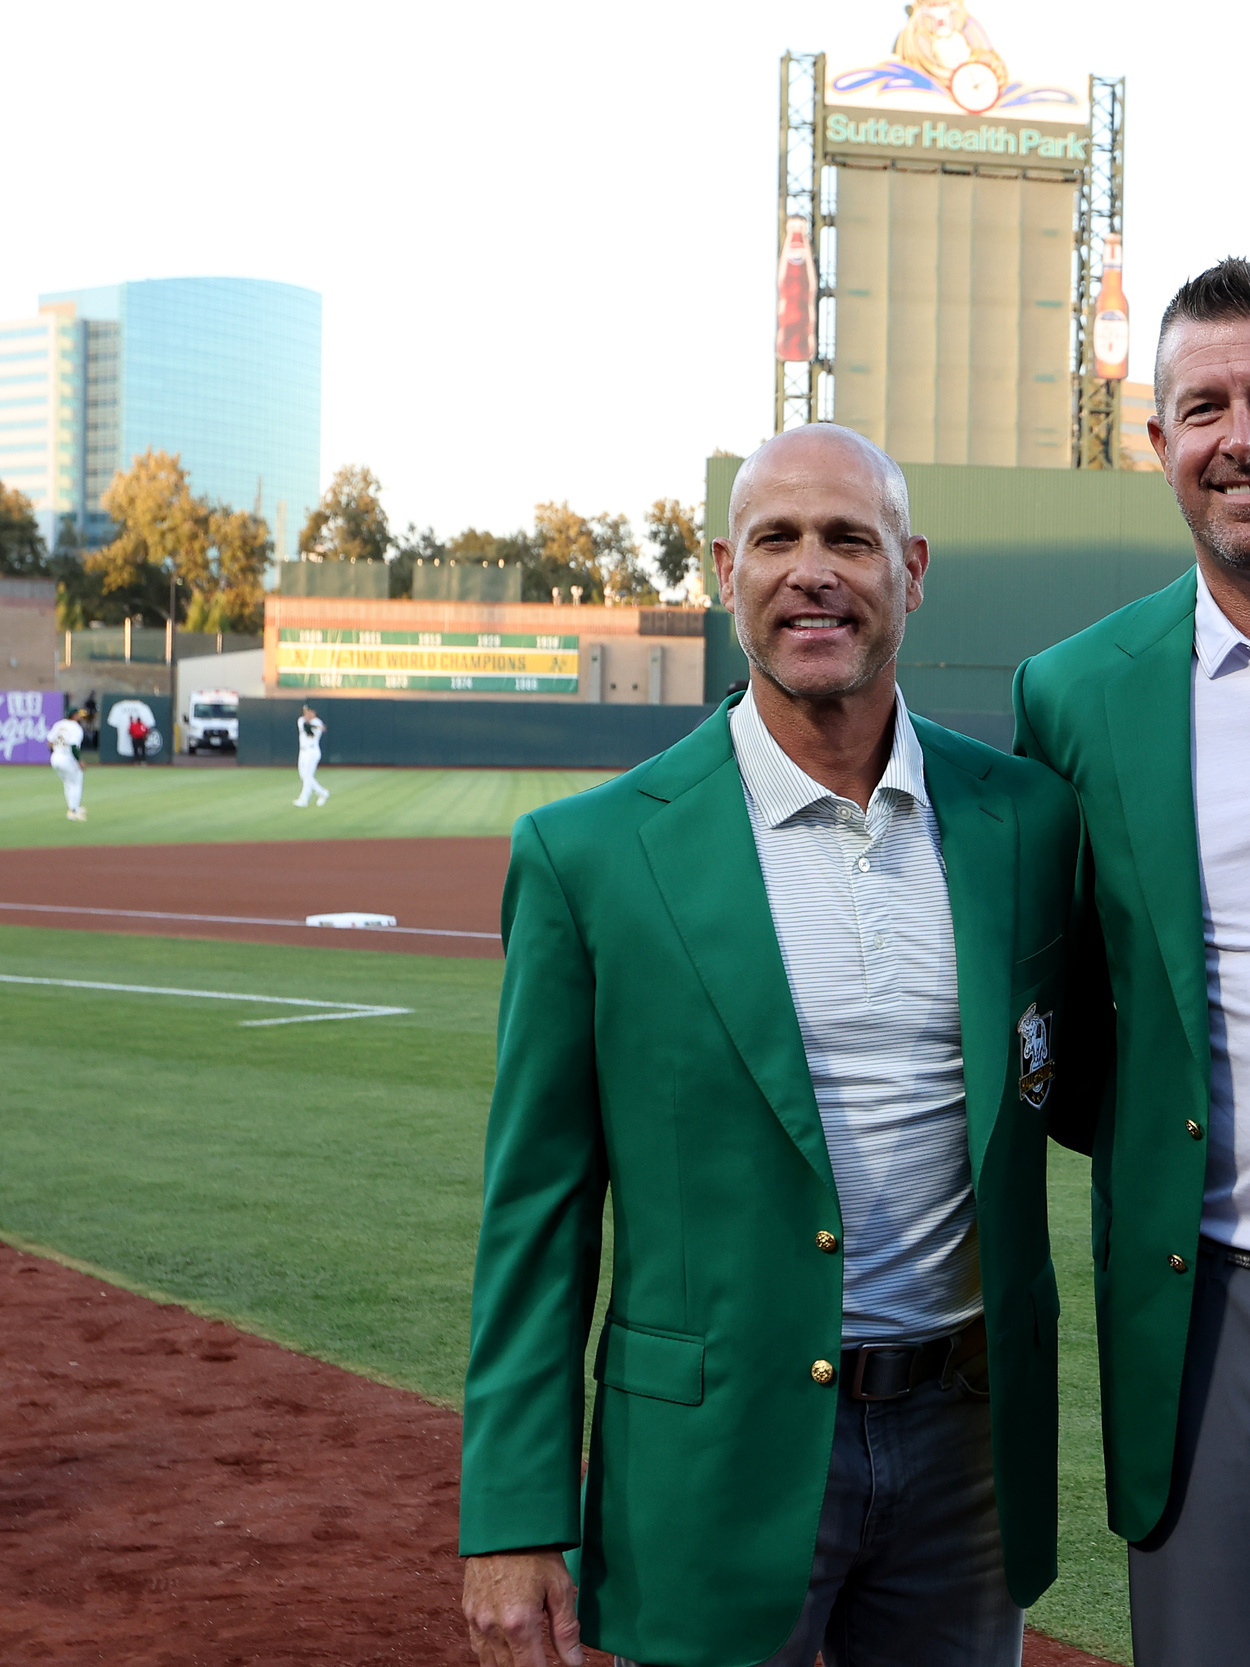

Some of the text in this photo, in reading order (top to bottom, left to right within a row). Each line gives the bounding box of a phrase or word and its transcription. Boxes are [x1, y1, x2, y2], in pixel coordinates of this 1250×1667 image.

[826, 113, 1086, 160] Sutter Health Park
[477, 634, 502, 648] 1929
[387, 652, 437, 670] WORLD
[439, 653, 526, 671] CHAMPIONS
[451, 677, 473, 690] 1974
